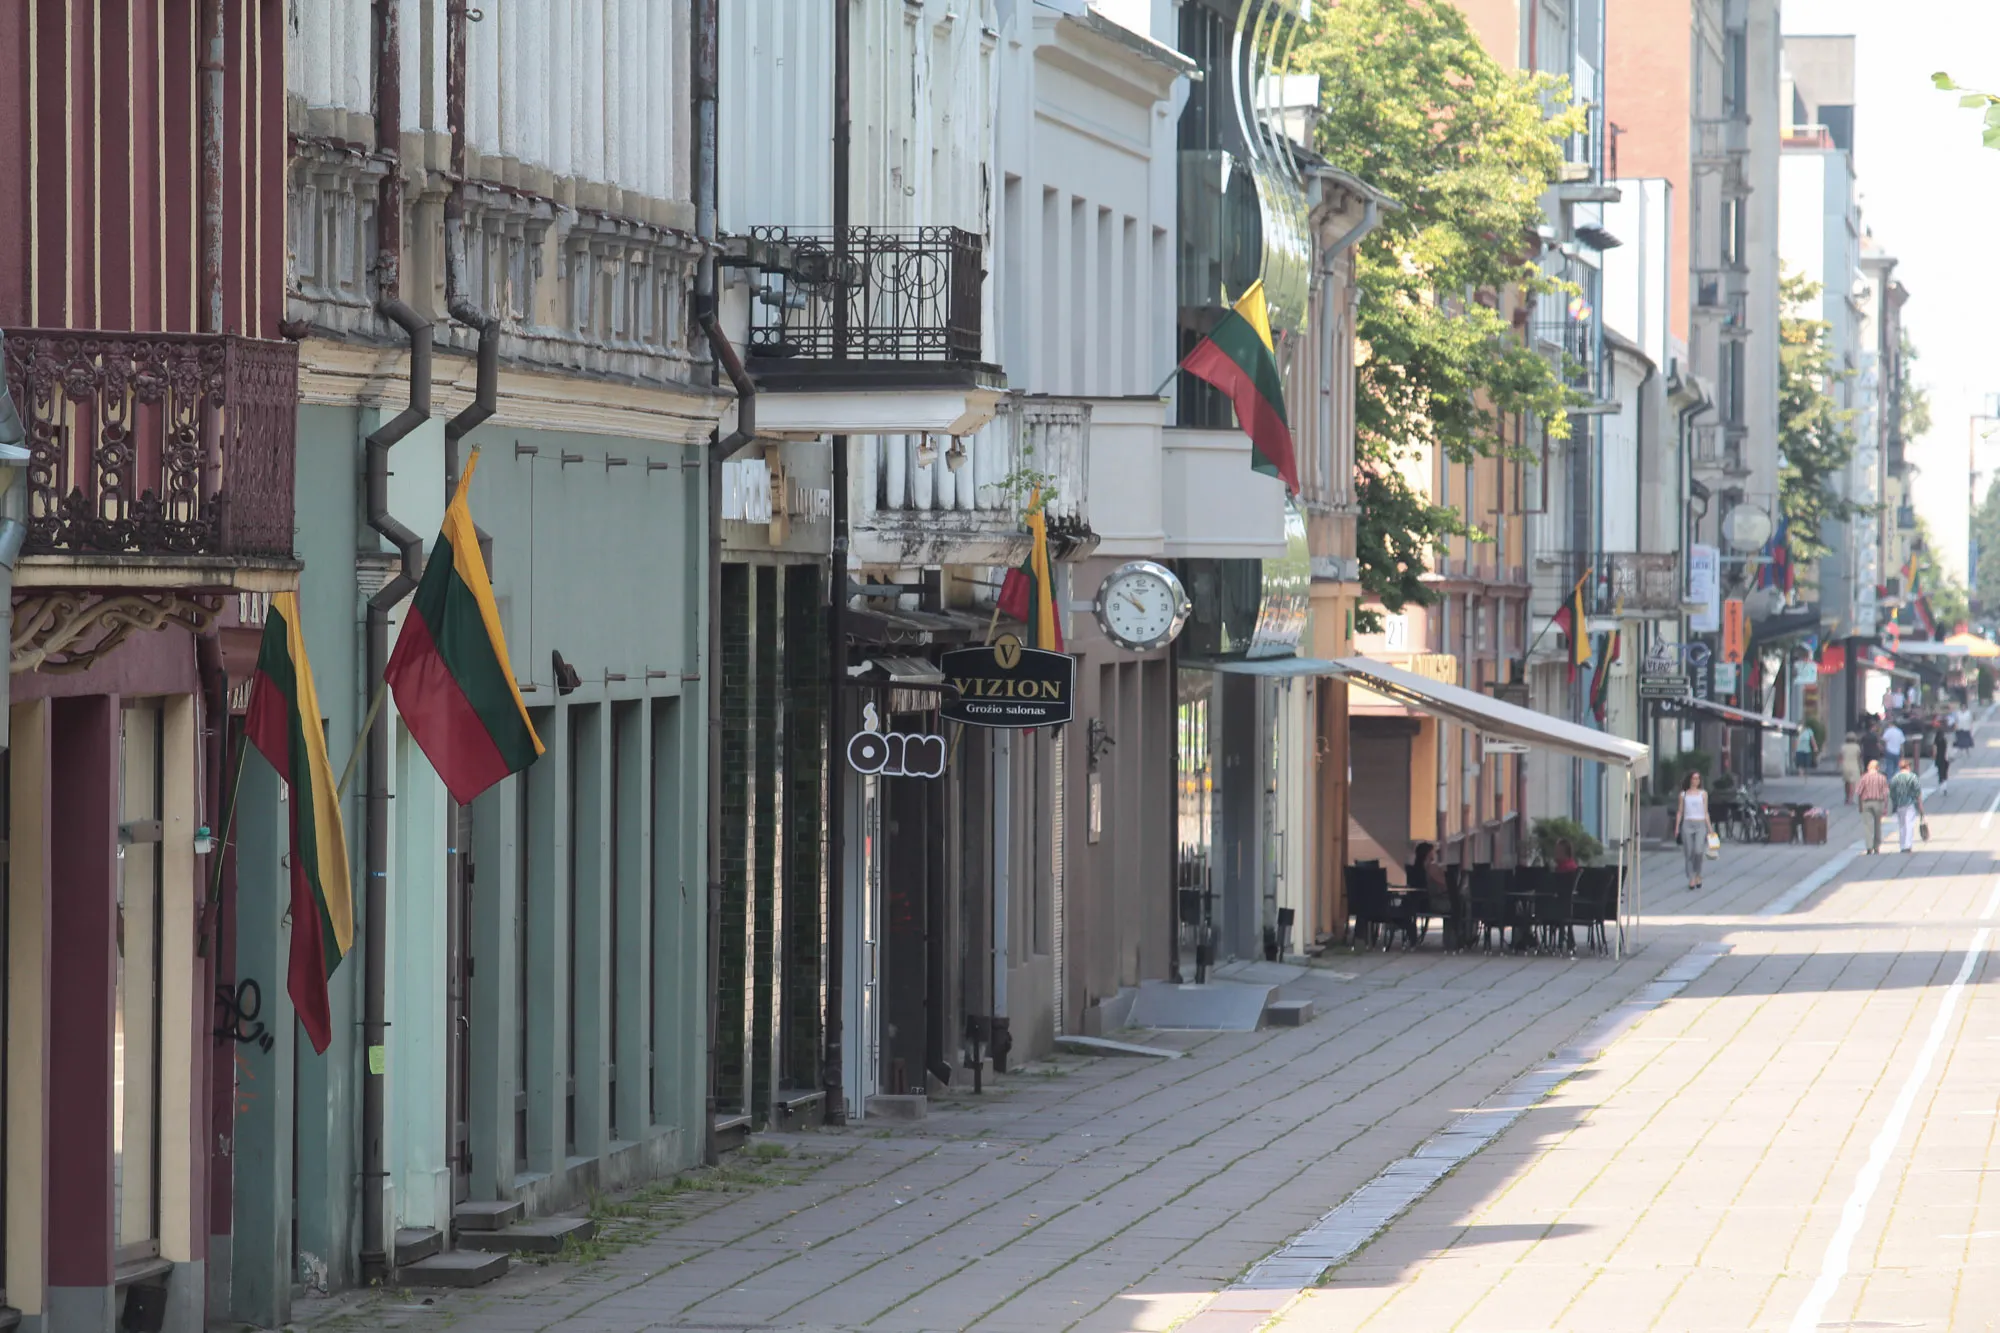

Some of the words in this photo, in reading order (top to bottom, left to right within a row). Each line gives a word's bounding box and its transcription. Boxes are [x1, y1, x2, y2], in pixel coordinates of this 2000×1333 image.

[1135, 580, 1146, 588] 12
[1113, 603, 1120, 612] 9
[1161, 603, 1168, 612] 3
[1136, 627, 1144, 636] 6
[1388, 621, 1403, 648] 21
[1000, 644, 1017, 665] V
[952, 677, 1062, 700] VIZION
[1006, 705, 1046, 716] salonas
